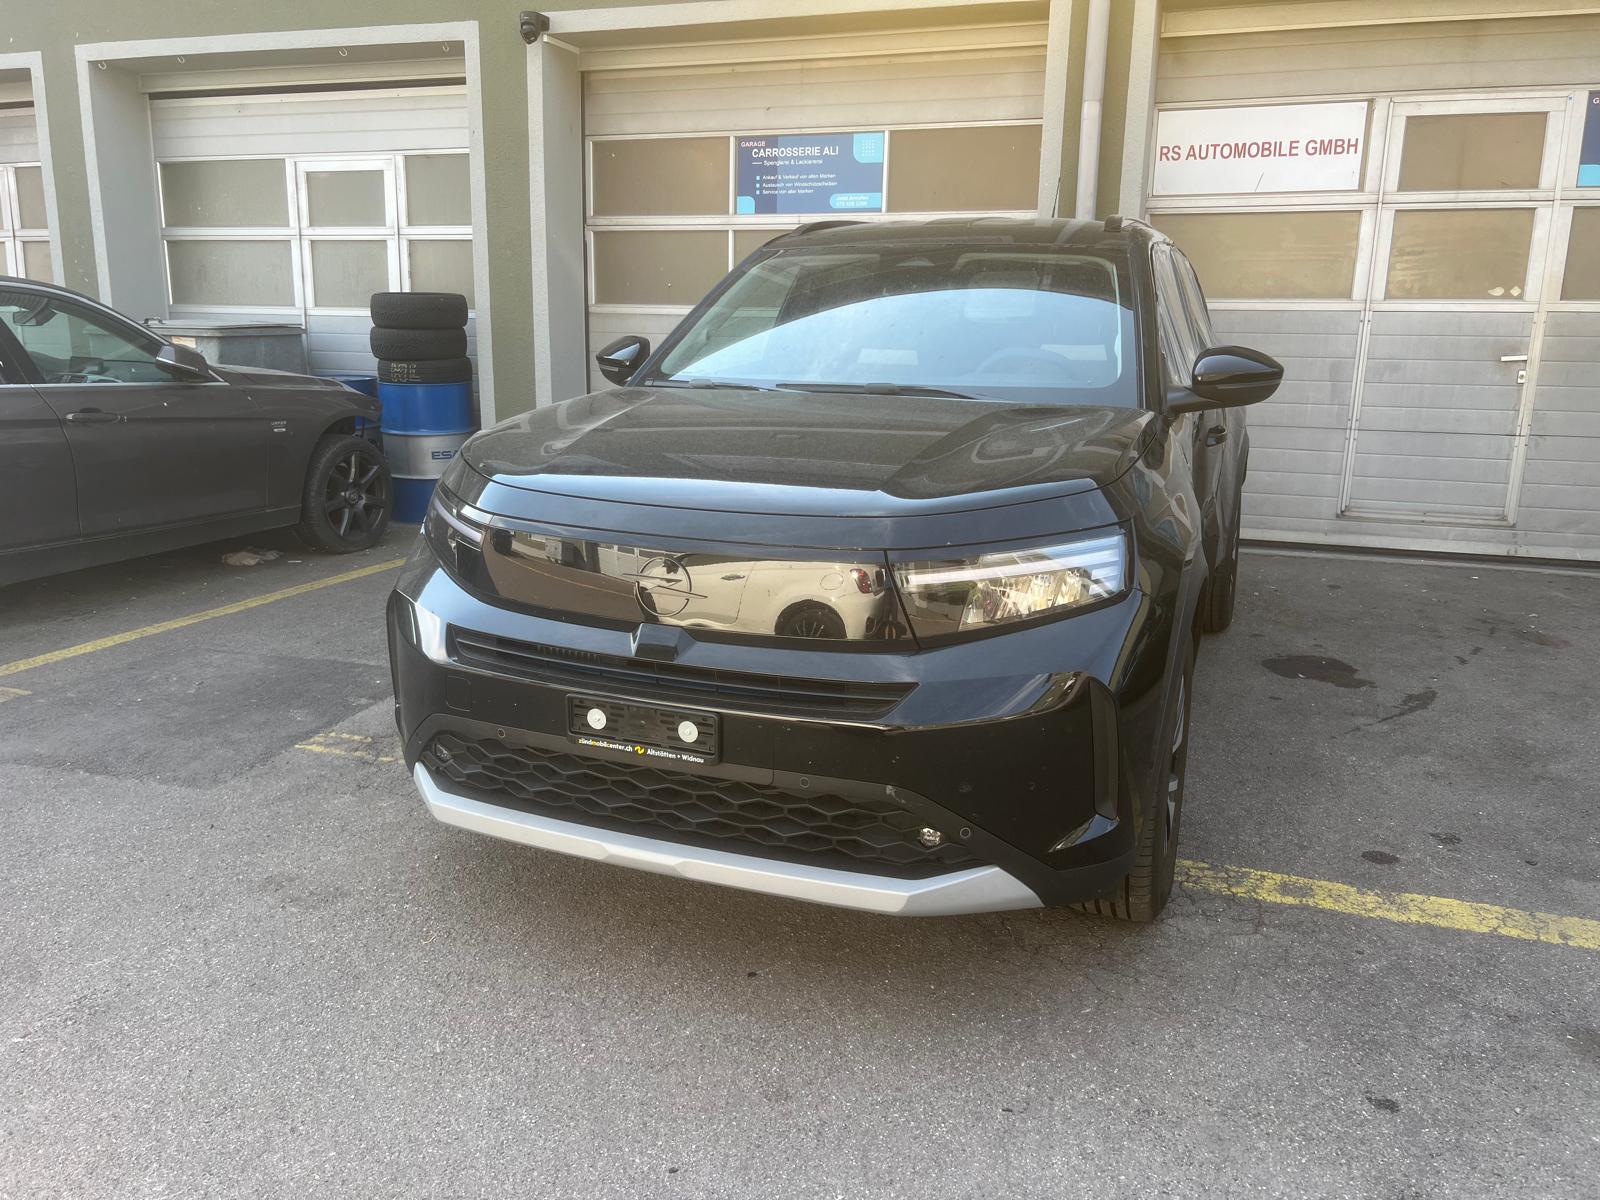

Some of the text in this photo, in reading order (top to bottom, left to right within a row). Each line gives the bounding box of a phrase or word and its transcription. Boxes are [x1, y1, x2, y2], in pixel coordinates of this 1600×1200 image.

[752, 145, 839, 158] CARROSSERIE ALI
[1159, 138, 1359, 162] RS AUTOMOBILE GMBH
